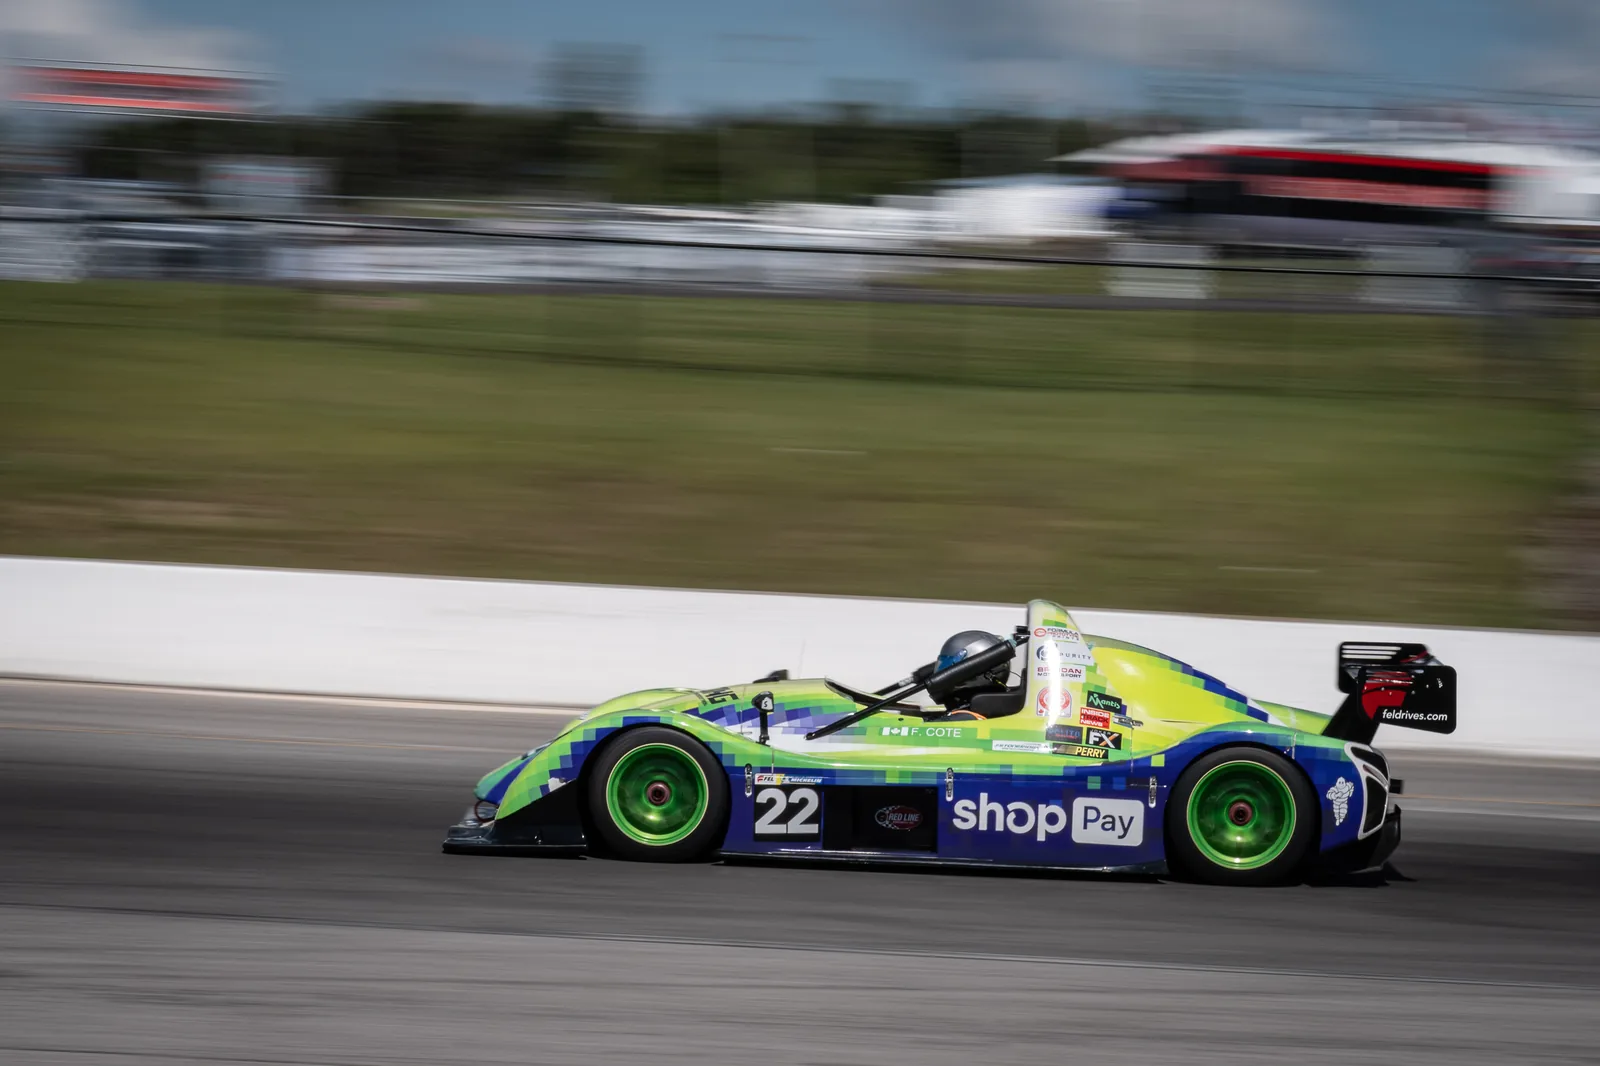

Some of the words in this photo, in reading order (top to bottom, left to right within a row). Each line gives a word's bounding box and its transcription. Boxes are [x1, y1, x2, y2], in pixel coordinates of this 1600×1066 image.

[1081, 708, 1109, 719] INSIDE
[1082, 714, 1109, 723] TRACK
[1382, 708, 1448, 721] feldrives.com
[1080, 719, 1104, 727] NEWS
[911, 727, 922, 737] F.
[926, 727, 962, 738] COTE
[1089, 731, 1119, 749] FX
[1075, 746, 1106, 759] PERRY
[754, 787, 819, 834] 22
[952, 792, 1067, 841] shop
[1083, 805, 1135, 839] Pay
[888, 812, 903, 821] RED
[903, 813, 920, 822] LINE
